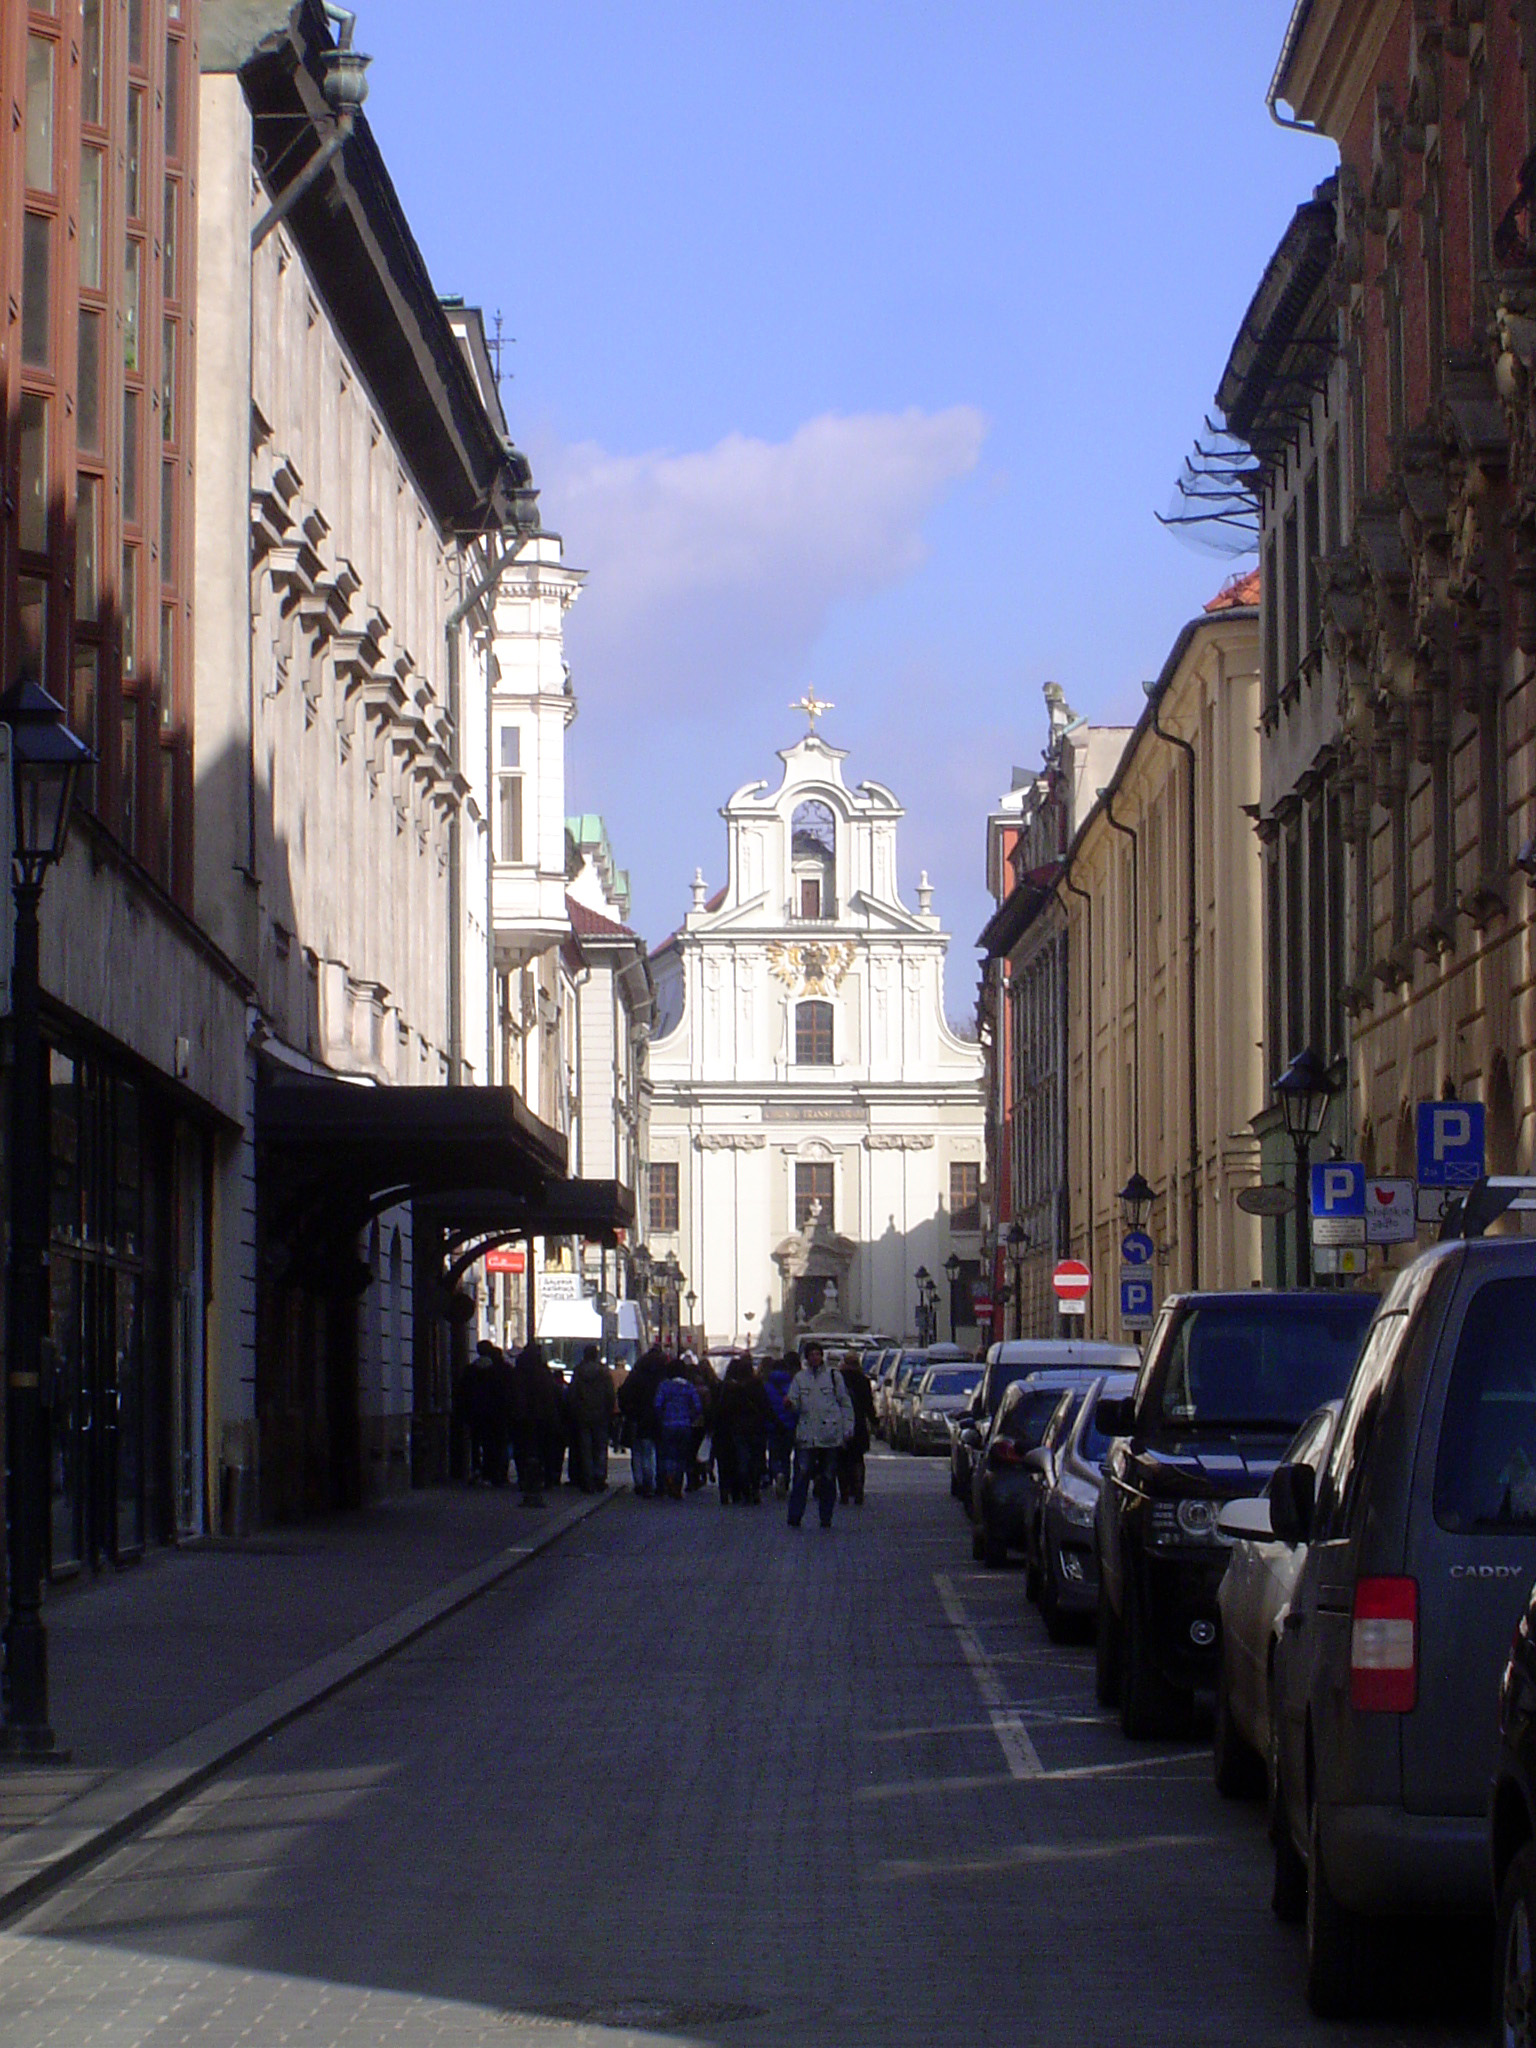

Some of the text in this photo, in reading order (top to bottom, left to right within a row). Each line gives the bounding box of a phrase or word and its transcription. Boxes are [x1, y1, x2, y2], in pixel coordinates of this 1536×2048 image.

[1433, 1110, 1470, 1160] P
[1324, 1168, 1354, 1210] P
[1128, 1285, 1146, 1309] P
[1450, 1565, 1523, 1578] CADDY
